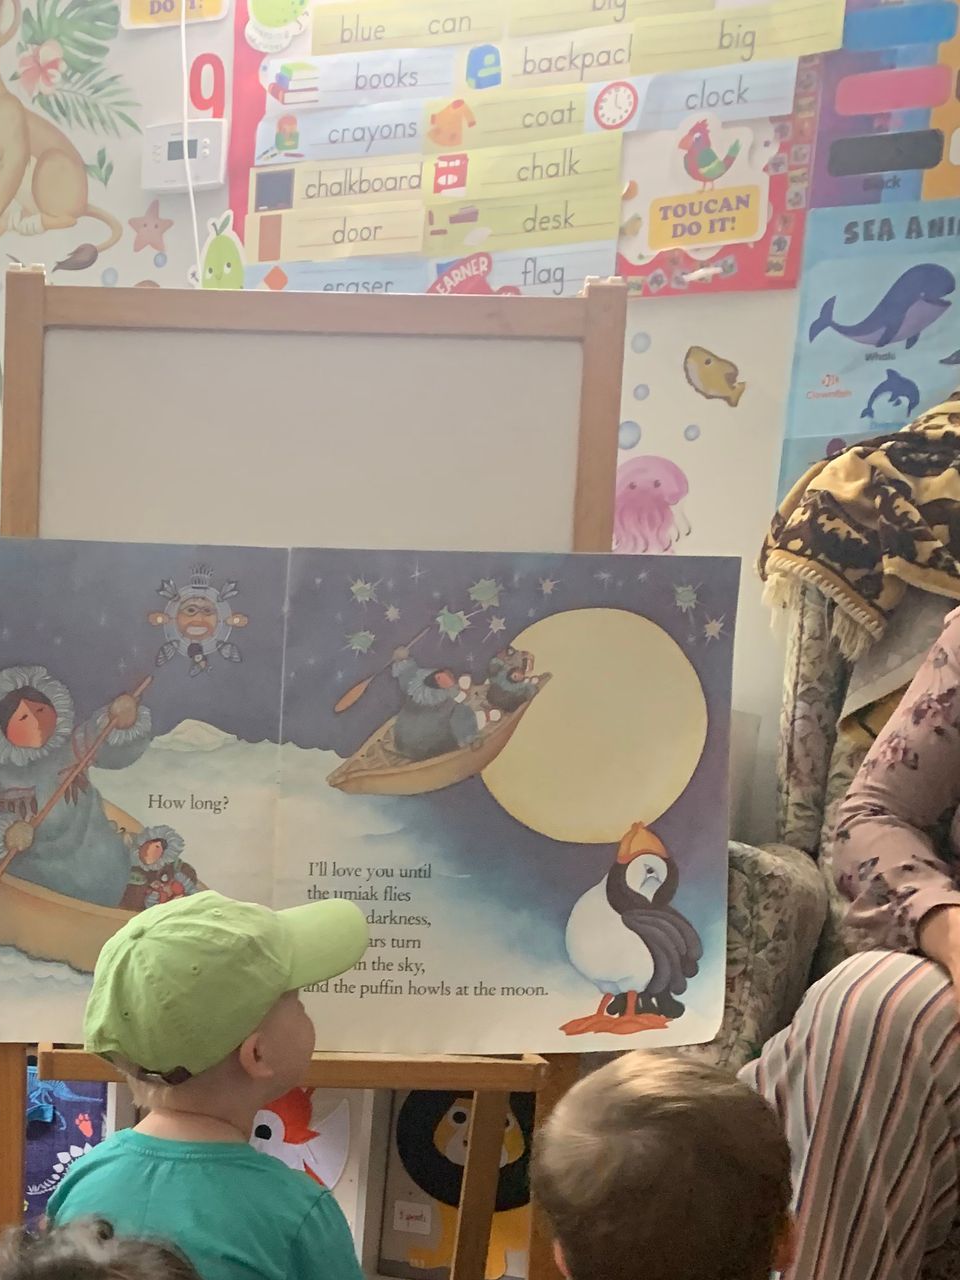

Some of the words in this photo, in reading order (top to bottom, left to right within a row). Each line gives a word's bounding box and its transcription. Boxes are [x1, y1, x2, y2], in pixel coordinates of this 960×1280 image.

[341, 15, 386, 44] blue
[428, 14, 472, 36] can
[718, 19, 757, 61] big
[189, 53, 226, 119] 9
[354, 60, 419, 91] books
[684, 75, 751, 111] clock
[521, 101, 577, 128] coat
[327, 118, 418, 152] crayons
[304, 161, 423, 200] chalkboard
[517, 149, 581, 183] chalk
[522, 200, 576, 234] desk
[659, 194, 751, 221] TOUCAN
[332, 216, 383, 246] door
[671, 221, 702, 239] DO
[707, 216, 737, 234] IT!
[844, 217, 896, 244] SEA
[905, 215, 960, 239] ANI
[436, 256, 489, 295] EARNER
[521, 257, 565, 295] flag
[147, 794, 185, 810] How
[190, 794, 229, 815] long?
[308, 861, 328, 877] I'll
[332, 861, 362, 877] love
[366, 867, 395, 882] you
[399, 863, 432, 879] until
[307, 884, 330, 900] the
[333, 885, 379, 901] umiak
[383, 885, 412, 902] flies
[365, 908, 432, 929] darkness,
[391, 936, 422, 949] turn
[371, 956, 394, 972] the
[397, 956, 426, 976] sky,
[334, 978, 357, 994] the
[360, 979, 403, 999] puffin
[408, 979, 452, 996] howls
[455, 985, 469, 996] at
[473, 980, 497, 996] the
[500, 985, 549, 997] moon.
